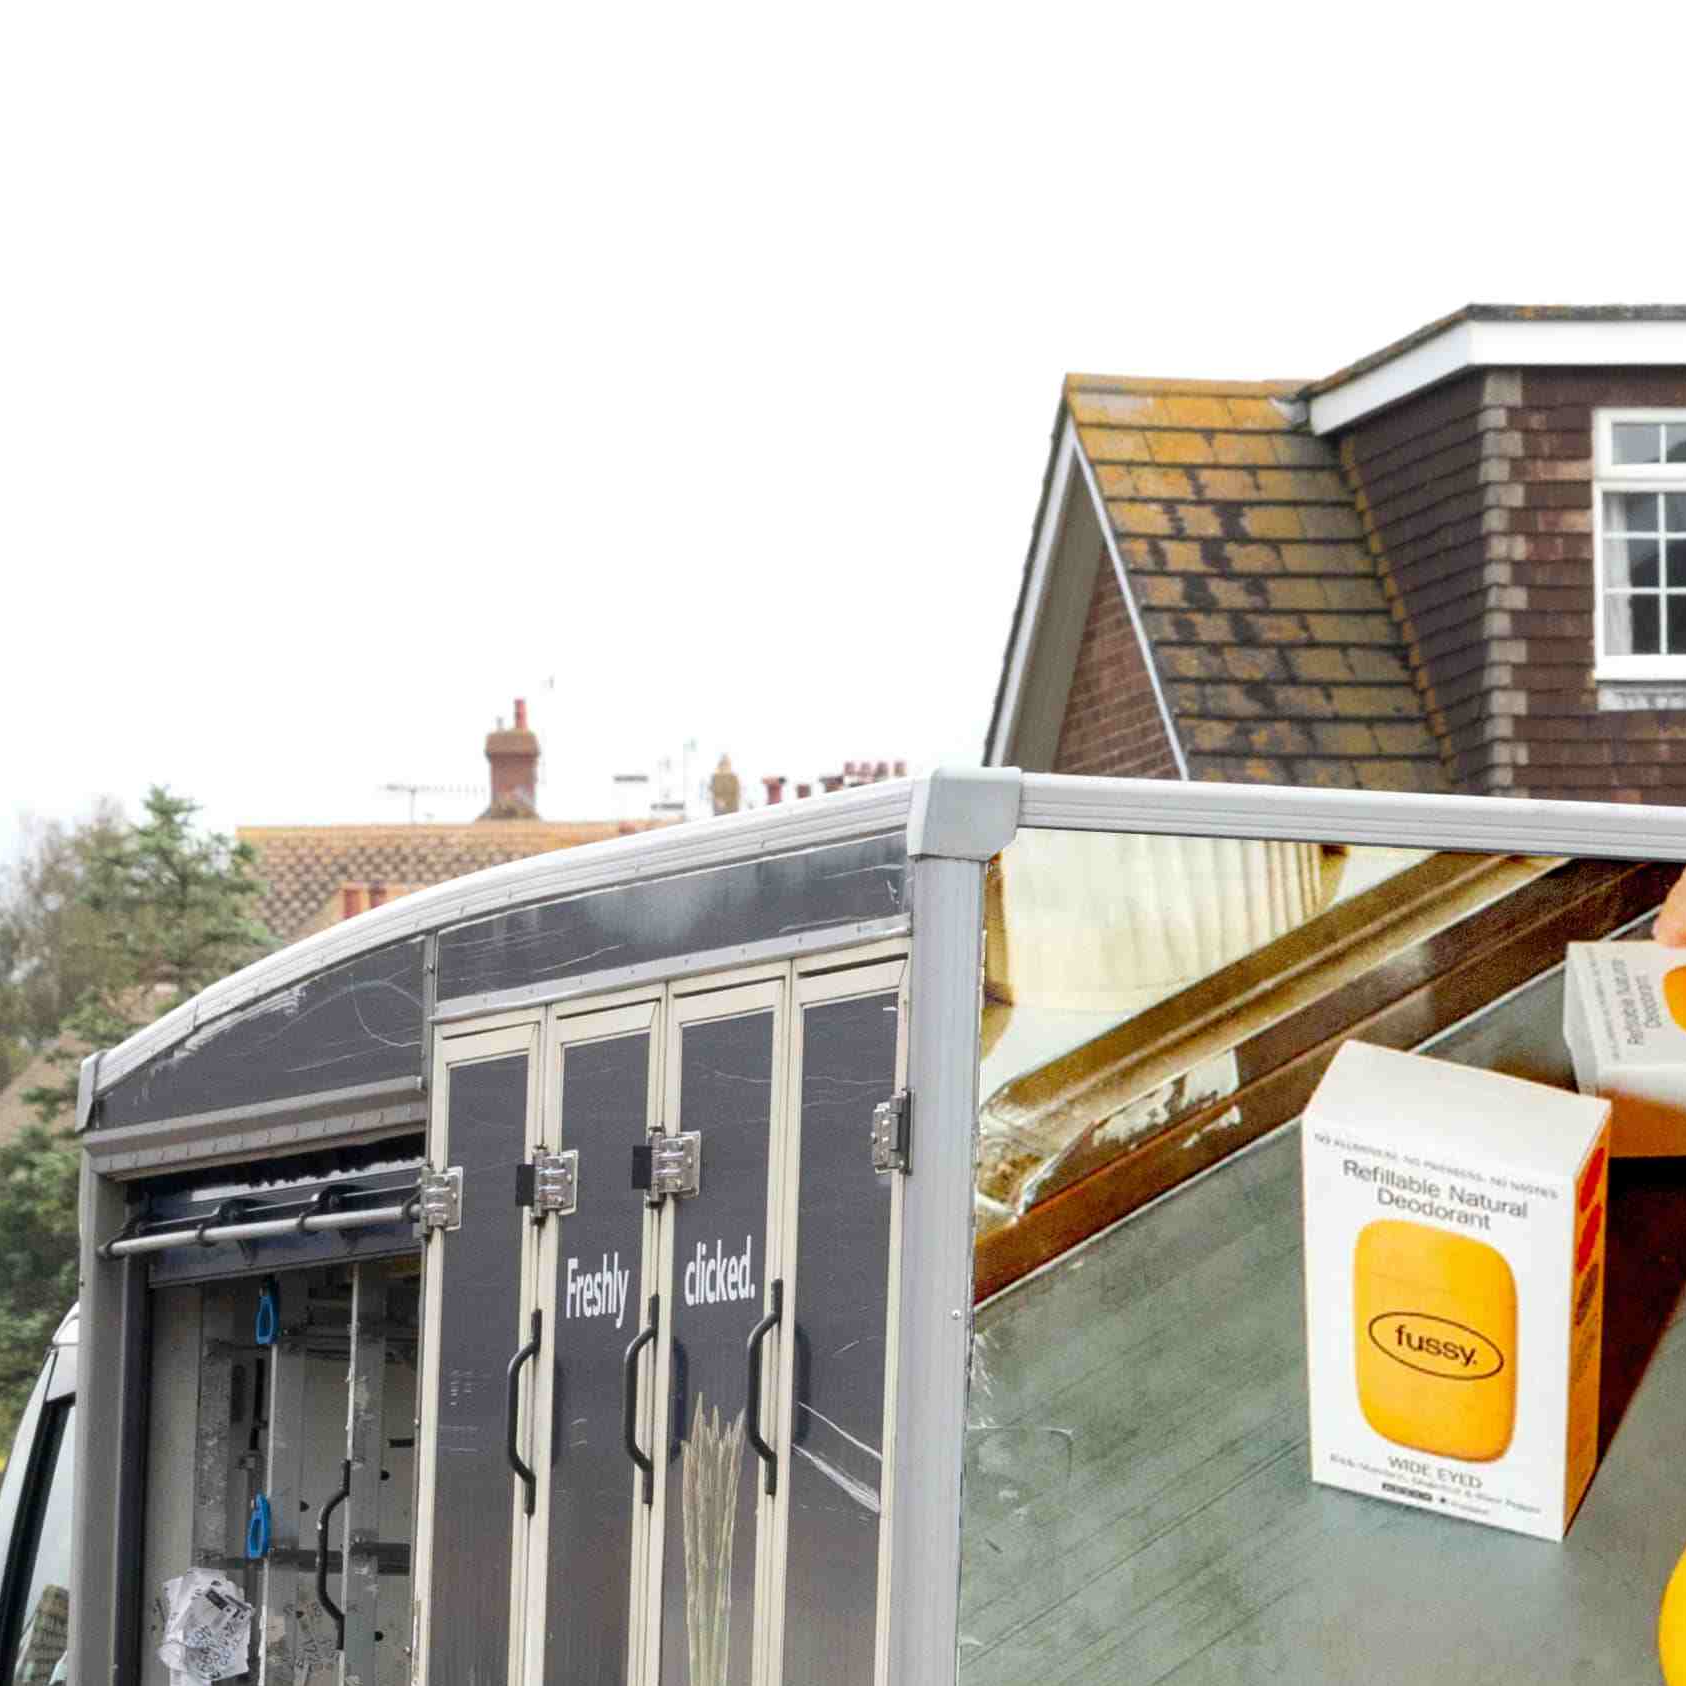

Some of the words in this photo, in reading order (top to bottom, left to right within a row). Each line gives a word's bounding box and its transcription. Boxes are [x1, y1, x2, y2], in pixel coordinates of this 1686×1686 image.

[1342, 1159, 1441, 1199] Refillable
[1448, 1184, 1528, 1219] Natural
[1376, 1186, 1491, 1231] Deodorant
[566, 1252, 629, 1329] Freshly
[684, 1234, 756, 1306] clicked.
